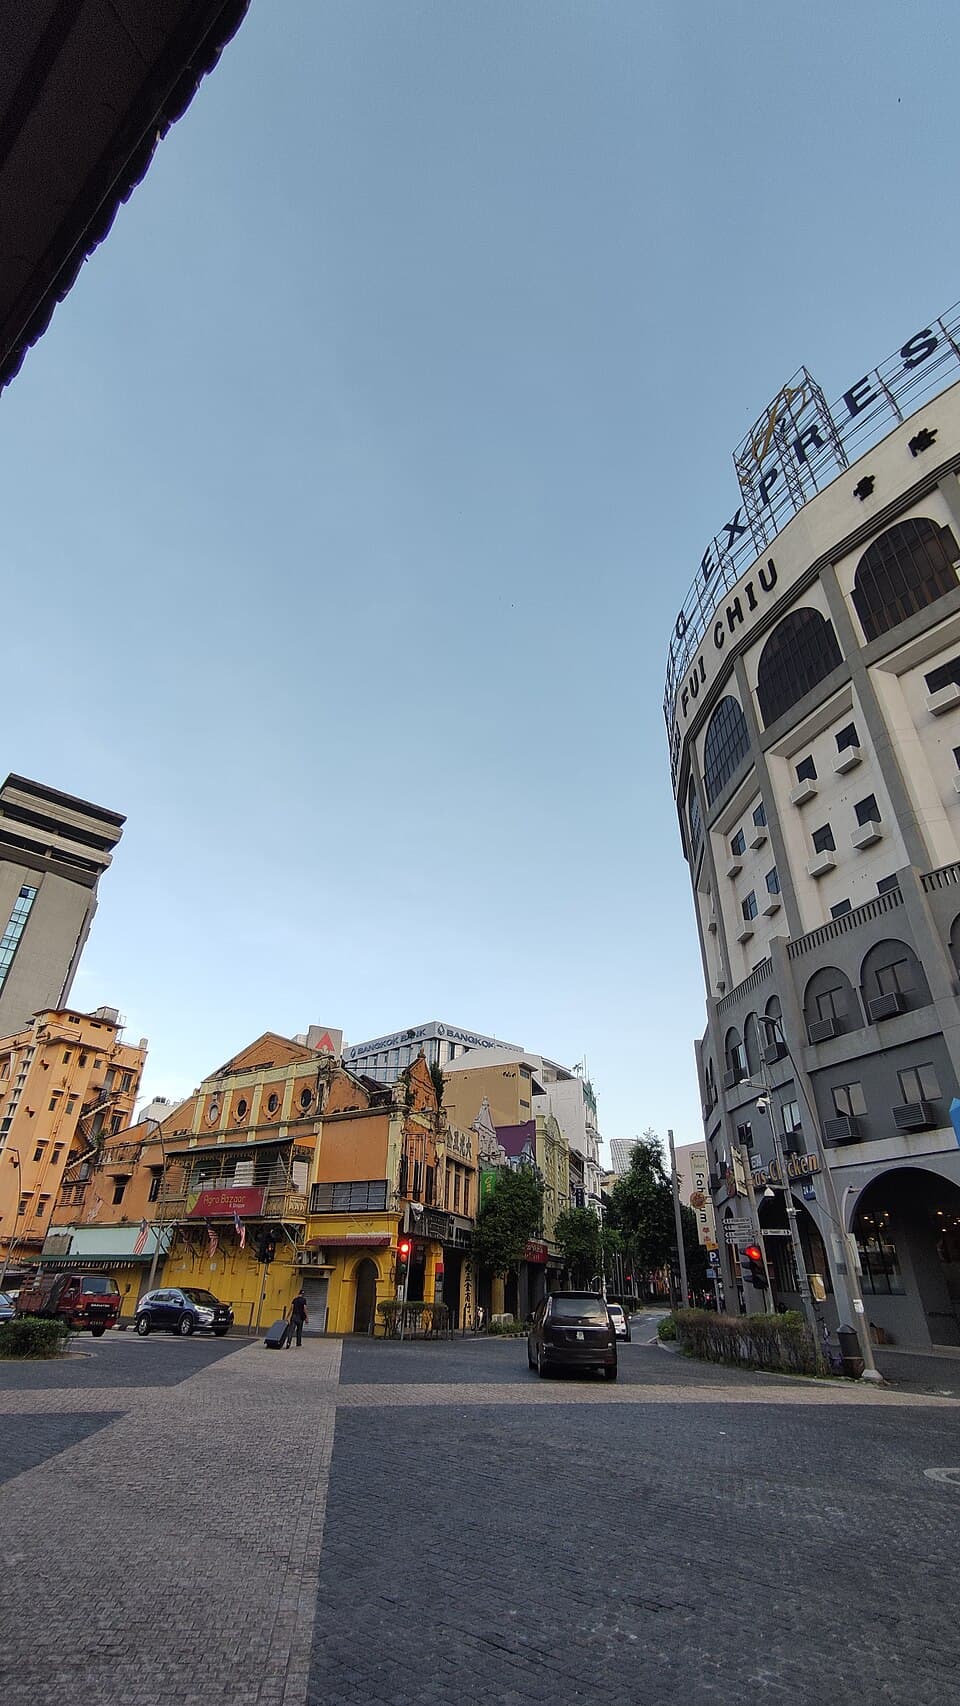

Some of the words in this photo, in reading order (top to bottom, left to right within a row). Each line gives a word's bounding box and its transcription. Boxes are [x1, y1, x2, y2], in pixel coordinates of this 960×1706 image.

[681, 656, 706, 717] FUI
[713, 558, 778, 650] CHIU
[357, 1036, 400, 1055] BANGKOK
[447, 1029, 496, 1049] BANGKOK
[769, 1153, 819, 1181] Chcken
